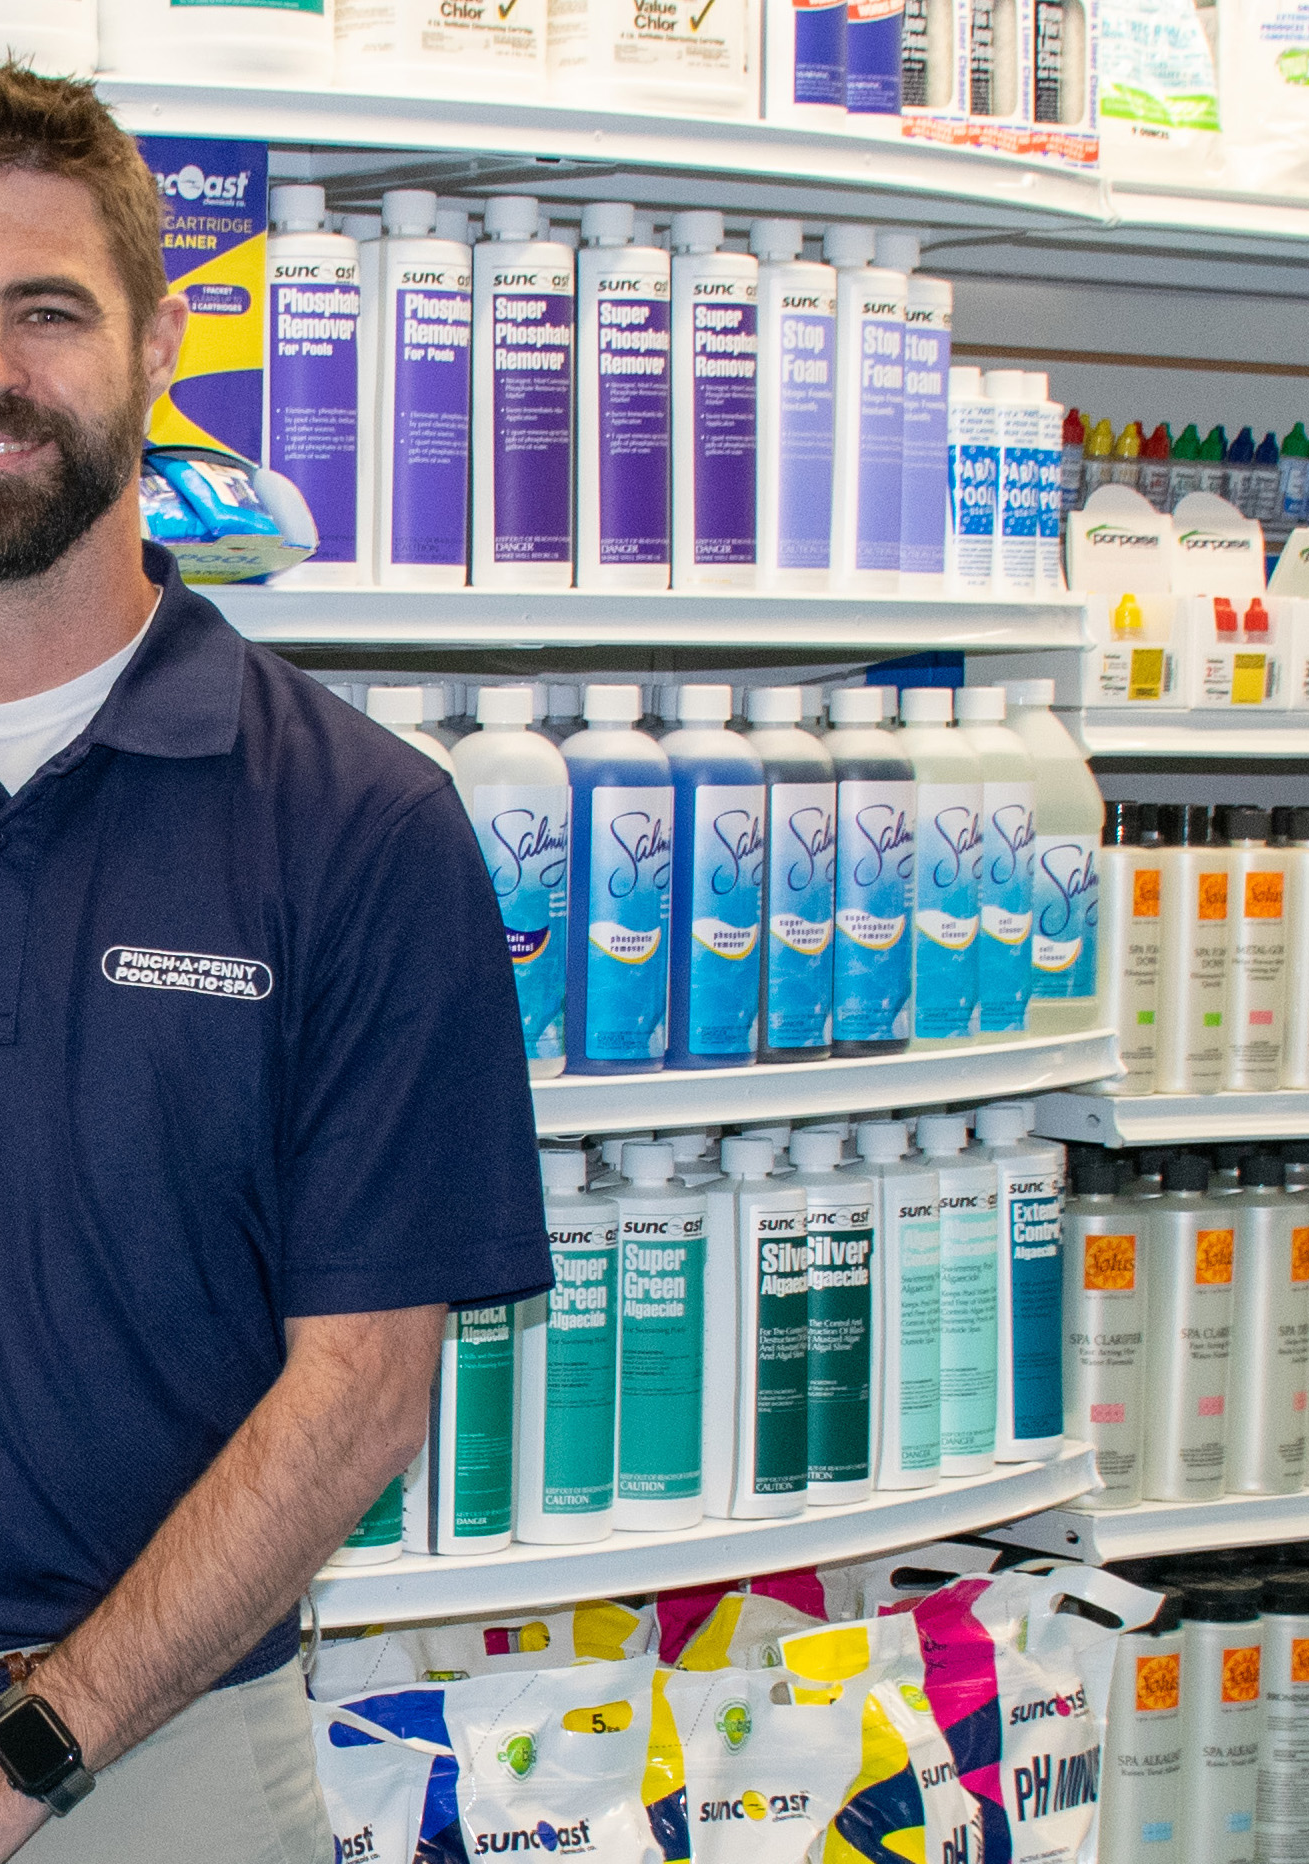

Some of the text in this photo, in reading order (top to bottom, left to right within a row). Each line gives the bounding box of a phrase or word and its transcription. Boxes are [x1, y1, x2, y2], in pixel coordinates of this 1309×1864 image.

[441, 1, 485, 20] Chlor
[634, 13, 678, 31] Chlor
[278, 287, 360, 317] Phosphate
[495, 297, 547, 322] Super
[600, 302, 650, 327] Super
[695, 305, 743, 330] Super
[278, 314, 354, 341] Remover
[783, 320, 825, 354] Stop
[278, 341, 334, 356] For Pools
[862, 325, 902, 359] Stop
[404, 347, 455, 362] For Pools
[495, 348, 564, 371] Remover
[600, 353, 666, 375] Remover
[782, 353, 828, 384] Foam
[862, 359, 904, 389] Foam
[905, 369, 942, 395] oam
[610, 935, 653, 945] phosphate
[713, 931, 752, 941] phosphate
[713, 941, 745, 949] remover
[610, 944, 645, 952] remover
[554, 1254, 608, 1283] Super
[624, 1243, 687, 1276] Super
[761, 1242, 808, 1274] Silve
[624, 1273, 686, 1300] Green
[807, 1268, 869, 1290] lgaecide
[549, 1284, 608, 1310] Green
[623, 1300, 685, 1319] Algaecide
[549, 1311, 607, 1331] Algaecide
[941, 1436, 975, 1446] DANGER
[620, 1481, 665, 1492] CAUTION
[755, 1482, 793, 1492] CAUTION
[545, 1495, 590, 1505] CAUTION
